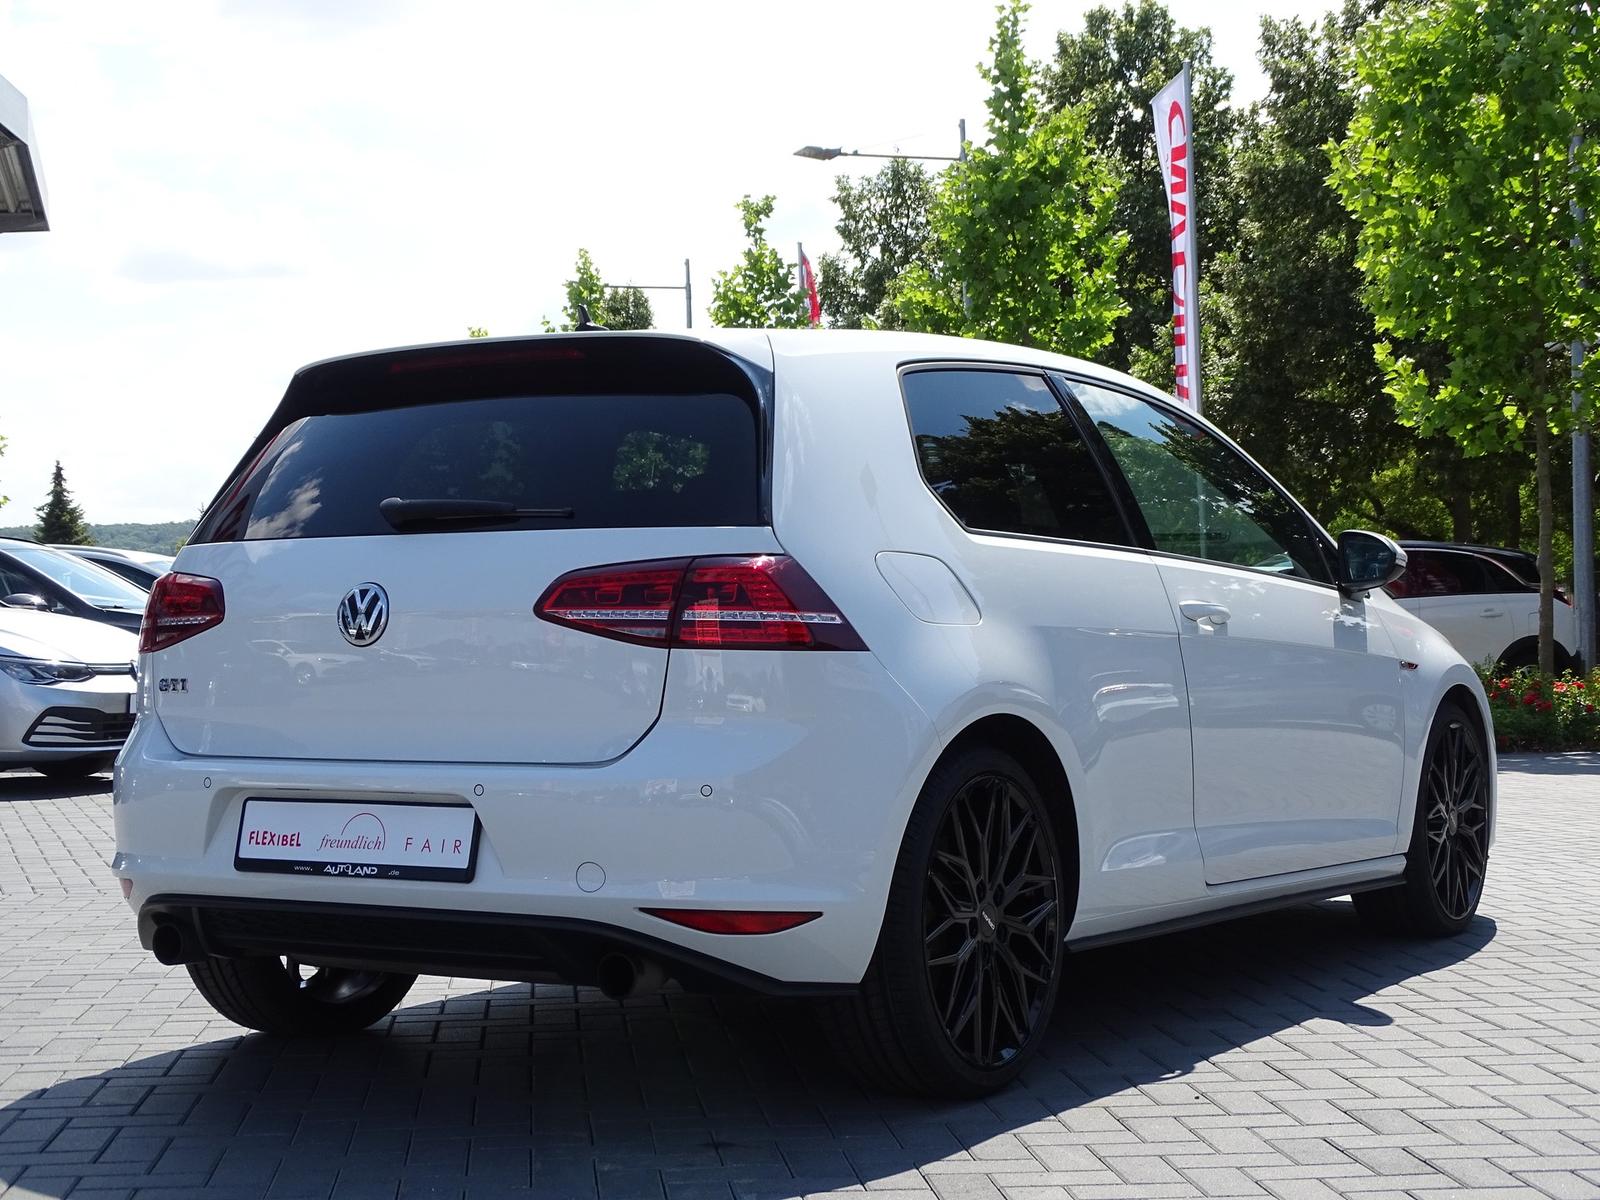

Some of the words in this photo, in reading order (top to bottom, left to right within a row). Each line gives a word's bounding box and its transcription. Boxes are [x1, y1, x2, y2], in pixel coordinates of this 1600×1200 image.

[159, 678, 188, 692] GTI
[248, 830, 302, 848] FLEXIBEL
[316, 833, 382, 852] freundlich
[404, 837, 462, 855] FAIR
[323, 863, 378, 876] AUTOLAND
